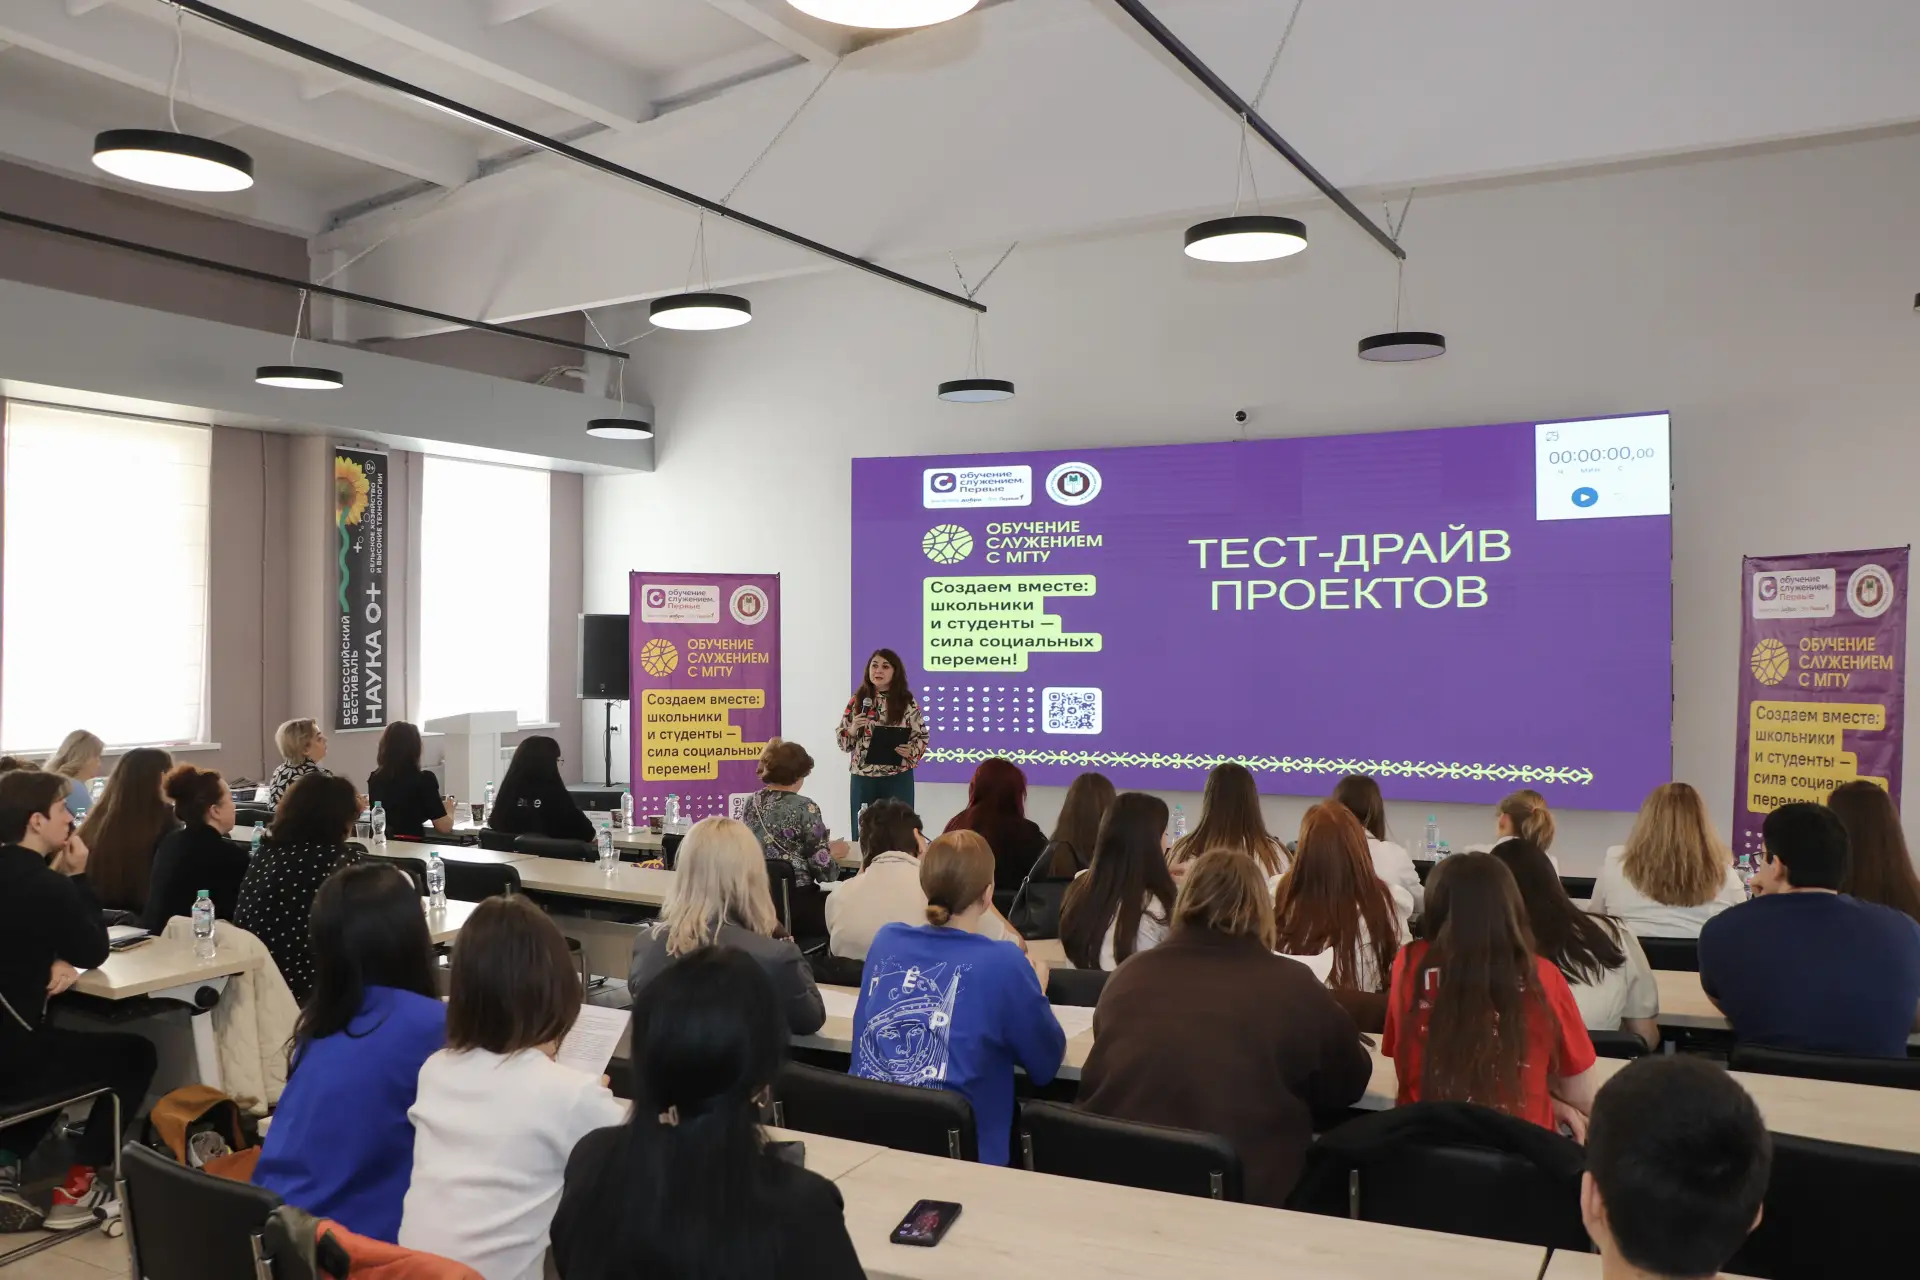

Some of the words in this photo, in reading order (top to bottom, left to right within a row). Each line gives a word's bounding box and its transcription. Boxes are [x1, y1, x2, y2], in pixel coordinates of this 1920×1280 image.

[960, 472, 1012, 480] обучение
[986, 520, 1080, 535] ОБУЧЕНИЕ
[986, 535, 1103, 549] СЛУЖЕНИЕМ
[1188, 523, 1512, 573] ТЕСТ-ДРАЙВ
[986, 551, 1000, 564] С
[1006, 550, 1051, 563] МГТУ
[1780, 575, 1821, 585] обучение
[930, 581, 1011, 595] Создаем
[1018, 581, 1089, 593] вместе:
[1211, 575, 1489, 611] ПРОЕКТОВ
[1780, 593, 1815, 601] Первые
[930, 601, 1034, 612] школьники
[930, 620, 941, 629] и
[947, 619, 1035, 632] студенты
[687, 638, 754, 650] ОБУЧЕНИЕ
[930, 638, 974, 648] сила
[979, 637, 1094, 649] социальных
[1799, 637, 1876, 652] ОБУЧЕНИЕ
[687, 652, 769, 664] СЛУЖЕНИЕМ
[930, 653, 1018, 668] перемен!
[1799, 655, 1894, 670] СЛУЖЕНИЕМ
[341, 615, 351, 725] ВСЕРОССИЙСКИЙ
[366, 629, 382, 724] НАУКА
[687, 666, 698, 678] С
[701, 666, 734, 677] МГТУ
[1799, 673, 1810, 687] С
[1814, 672, 1850, 688] МГТУ
[350, 650, 359, 725] ФЕСТИВАЛЬ
[647, 693, 706, 706] Создаем
[710, 695, 760, 705] вместе:
[647, 712, 722, 723] школьники
[1756, 705, 1817, 723] Создаем
[1822, 710, 1880, 725] вместе:
[647, 731, 656, 740] и
[659, 730, 722, 742] студенты
[1755, 730, 1835, 745] школьники
[647, 747, 679, 757] сила
[683, 746, 763, 759] социальных
[1755, 752, 1763, 763] и
[1767, 752, 1834, 768] студенты
[647, 762, 711, 777] перемен!
[1753, 772, 1786, 786] сила
